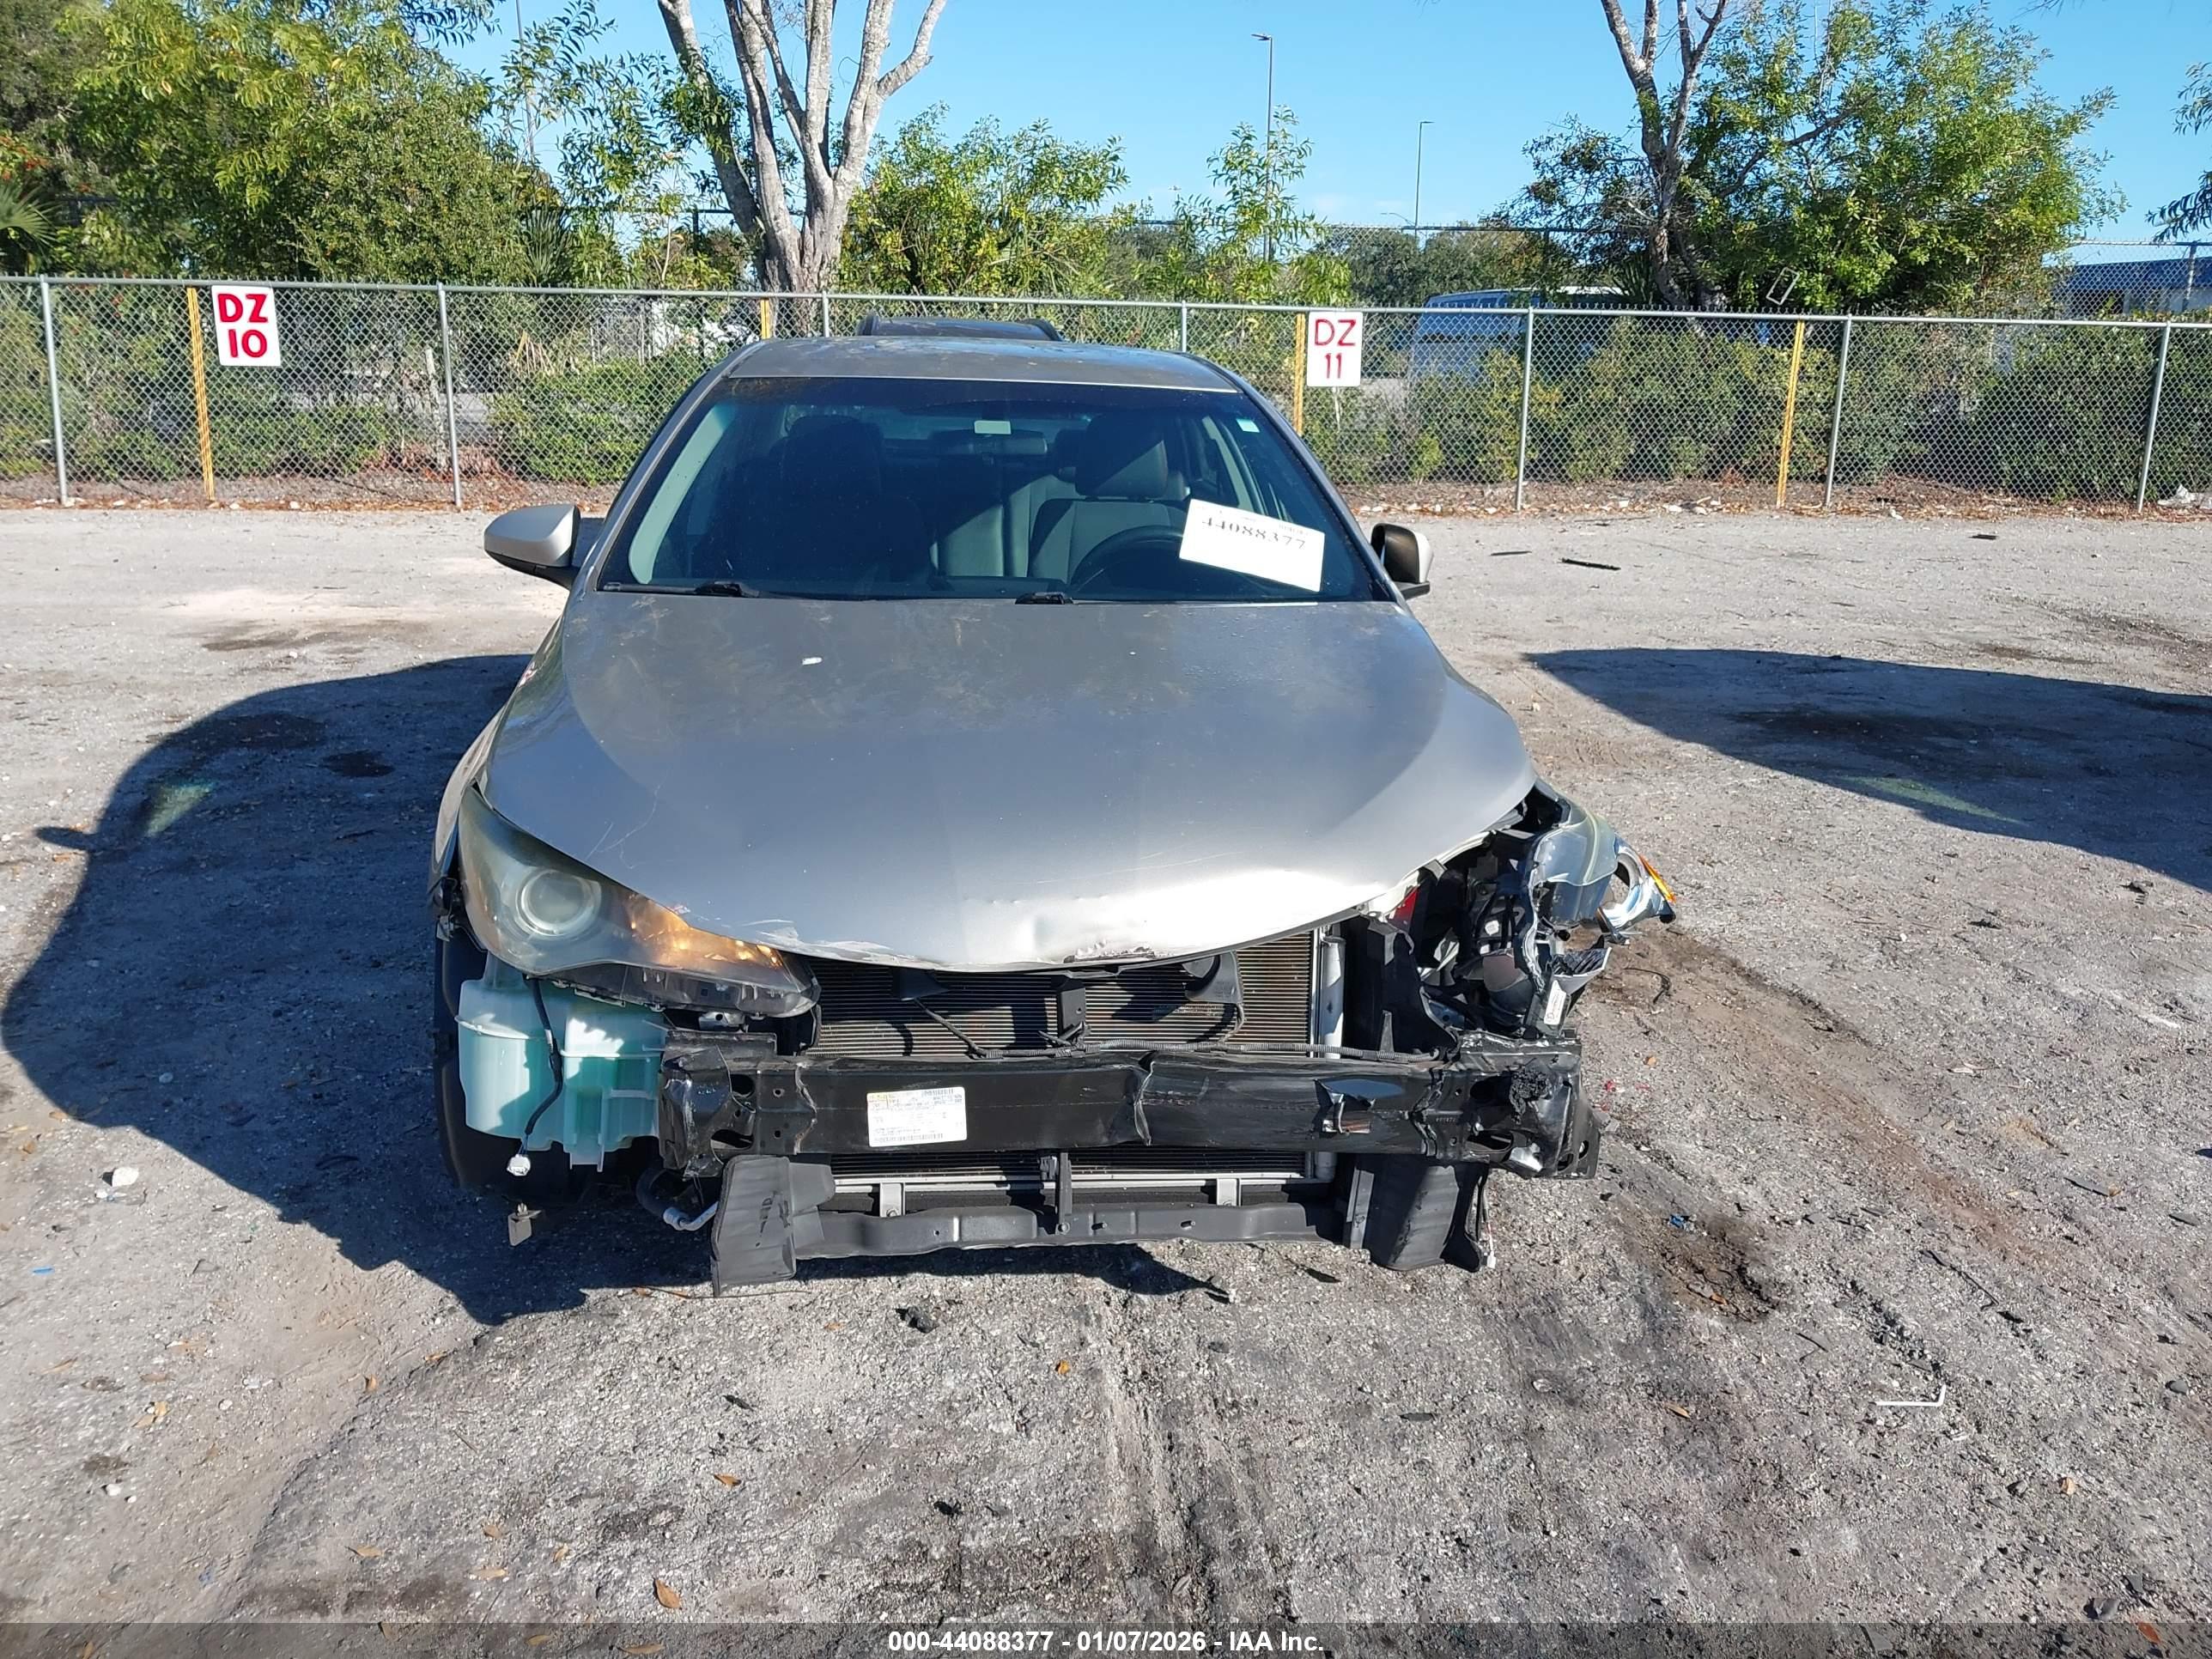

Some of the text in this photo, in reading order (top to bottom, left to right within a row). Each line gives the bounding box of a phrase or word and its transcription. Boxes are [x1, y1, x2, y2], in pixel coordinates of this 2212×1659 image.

[216, 293, 269, 323] DZ
[228, 328, 268, 358] 10
[1314, 318, 1357, 346] DZ
[1324, 352, 1342, 379] 11
[1201, 516, 1306, 550] 44088377
